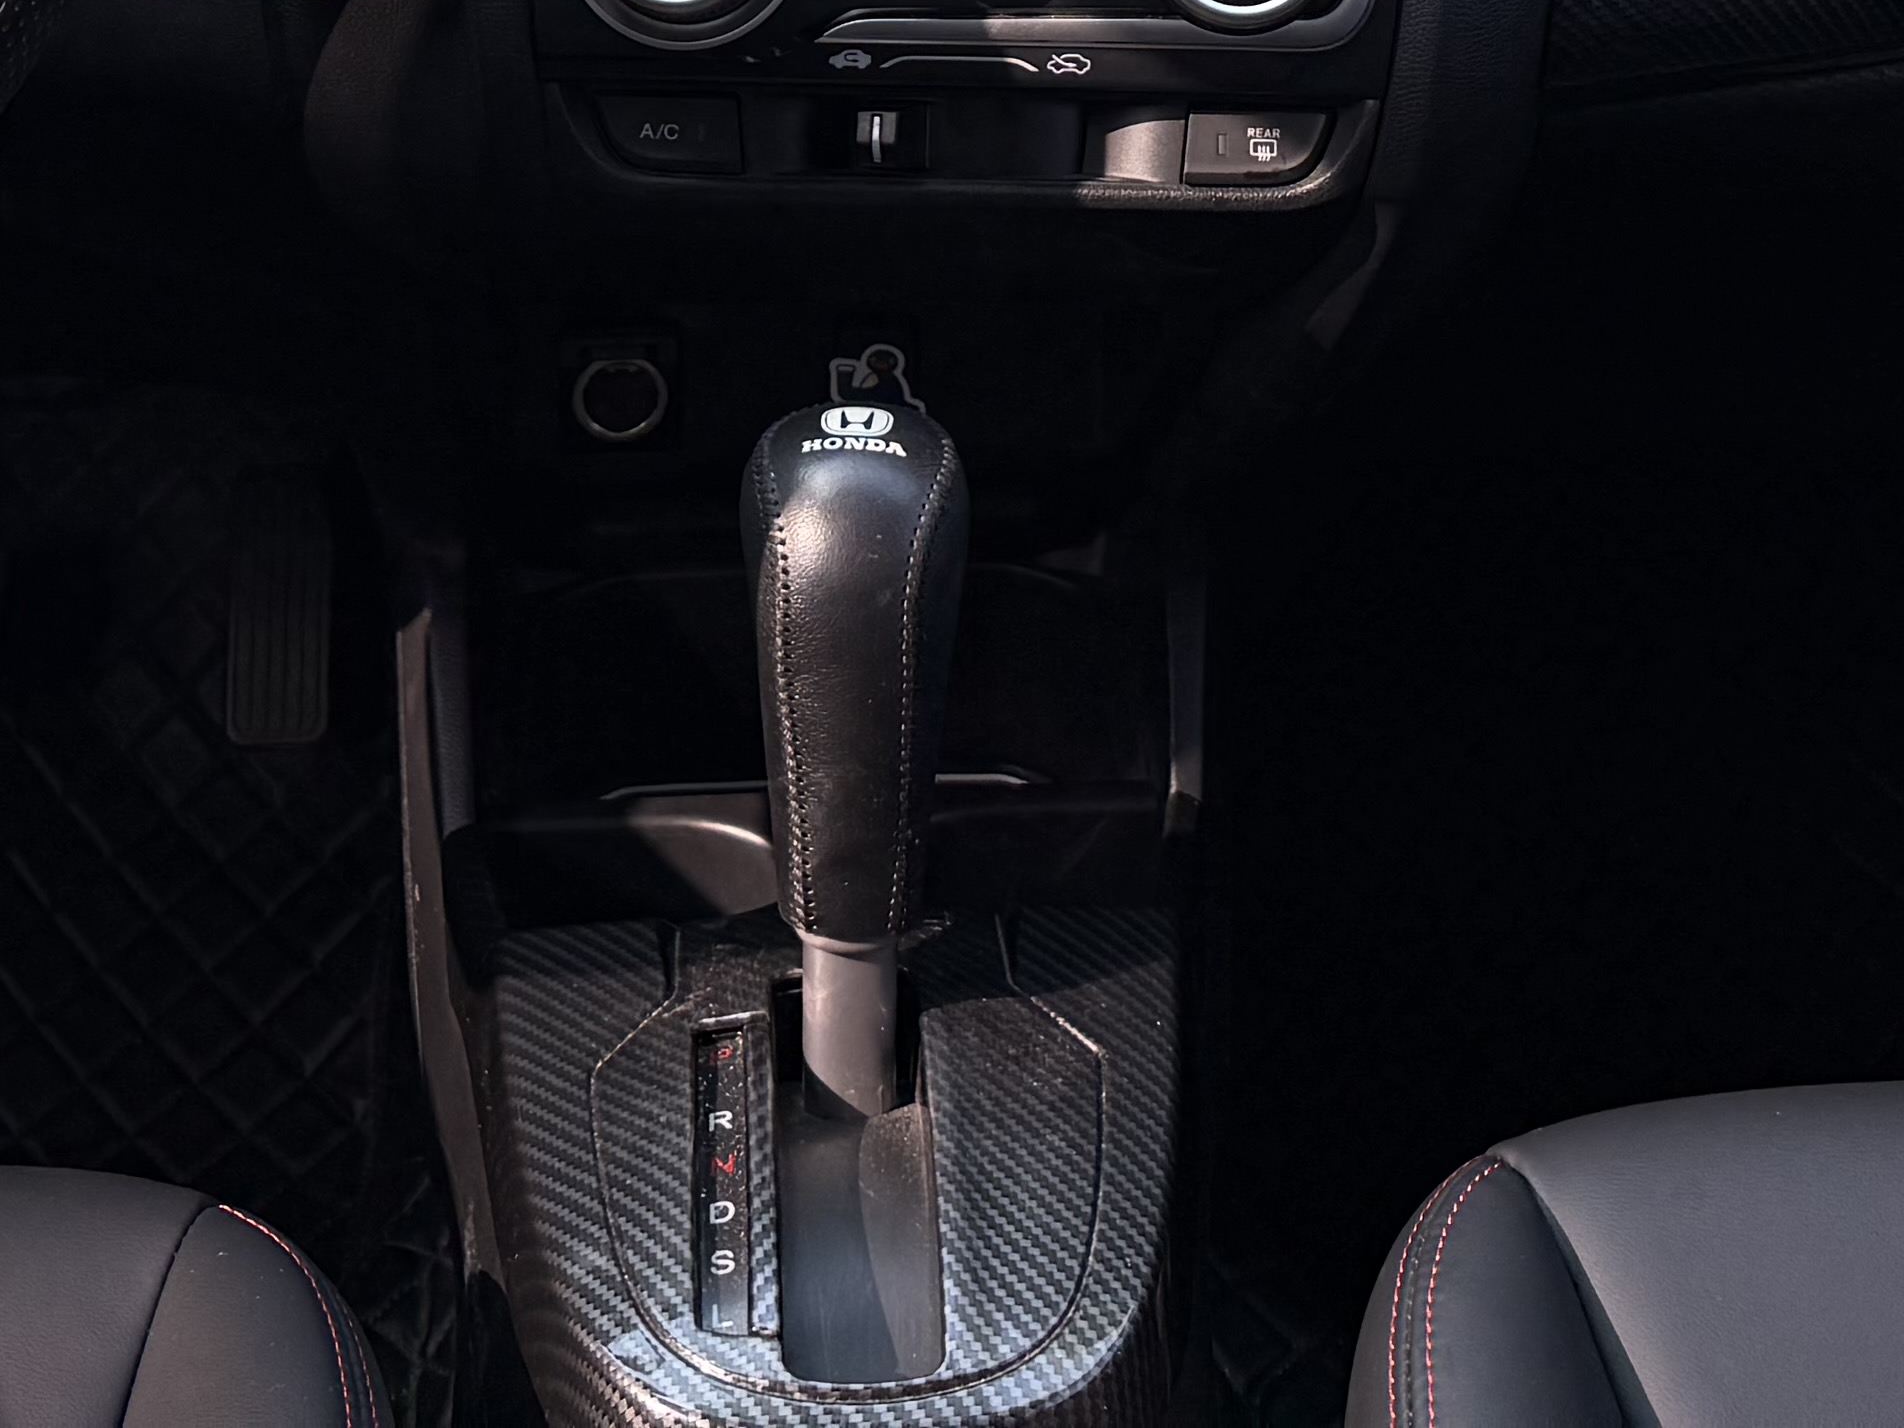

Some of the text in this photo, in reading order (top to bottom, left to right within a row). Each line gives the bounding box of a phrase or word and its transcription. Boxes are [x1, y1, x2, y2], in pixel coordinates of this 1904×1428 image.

[639, 123, 679, 140] A/C
[1247, 128, 1280, 138] REAR
[801, 437, 907, 457] HONDA
[708, 1112, 732, 1131] R
[711, 1156, 735, 1175] N
[709, 1201, 734, 1223] D
[711, 1250, 735, 1274] S
[712, 1305, 732, 1326] L
